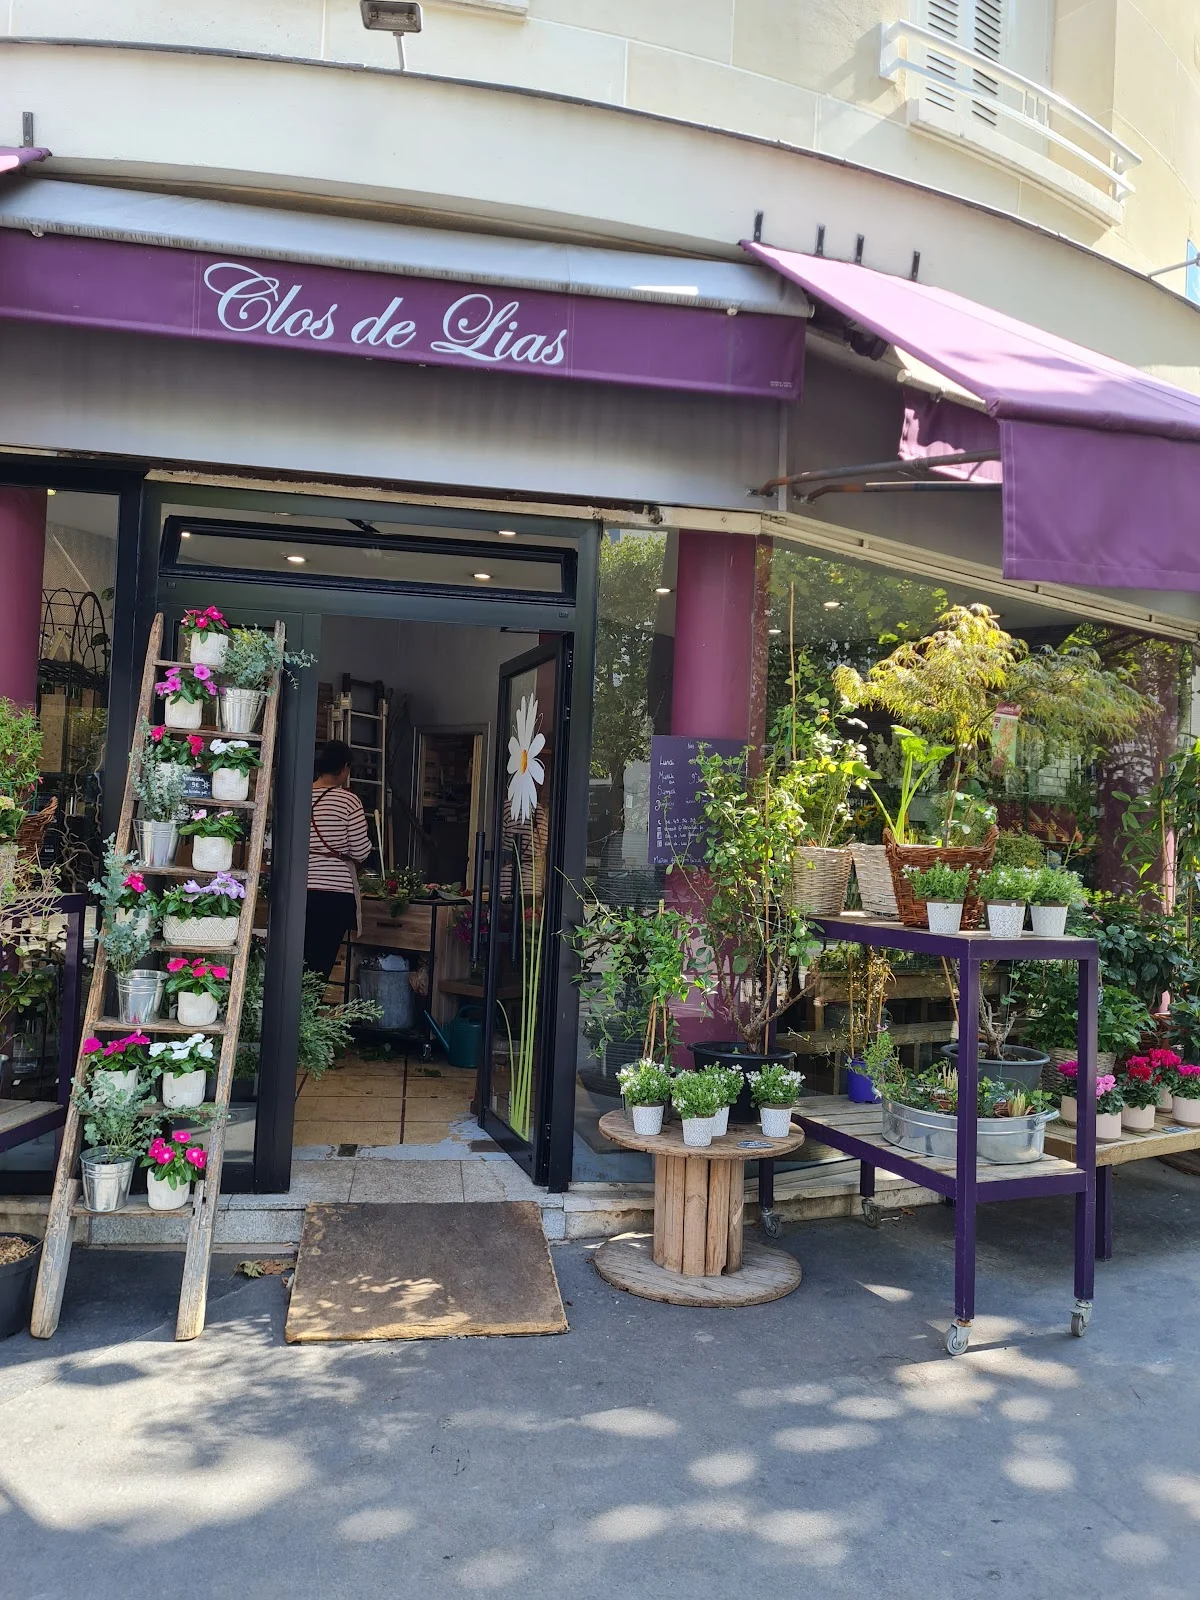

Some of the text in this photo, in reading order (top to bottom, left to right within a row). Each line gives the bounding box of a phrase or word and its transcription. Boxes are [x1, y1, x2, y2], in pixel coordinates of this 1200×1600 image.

[203, 262, 568, 365] Clos de Lias
